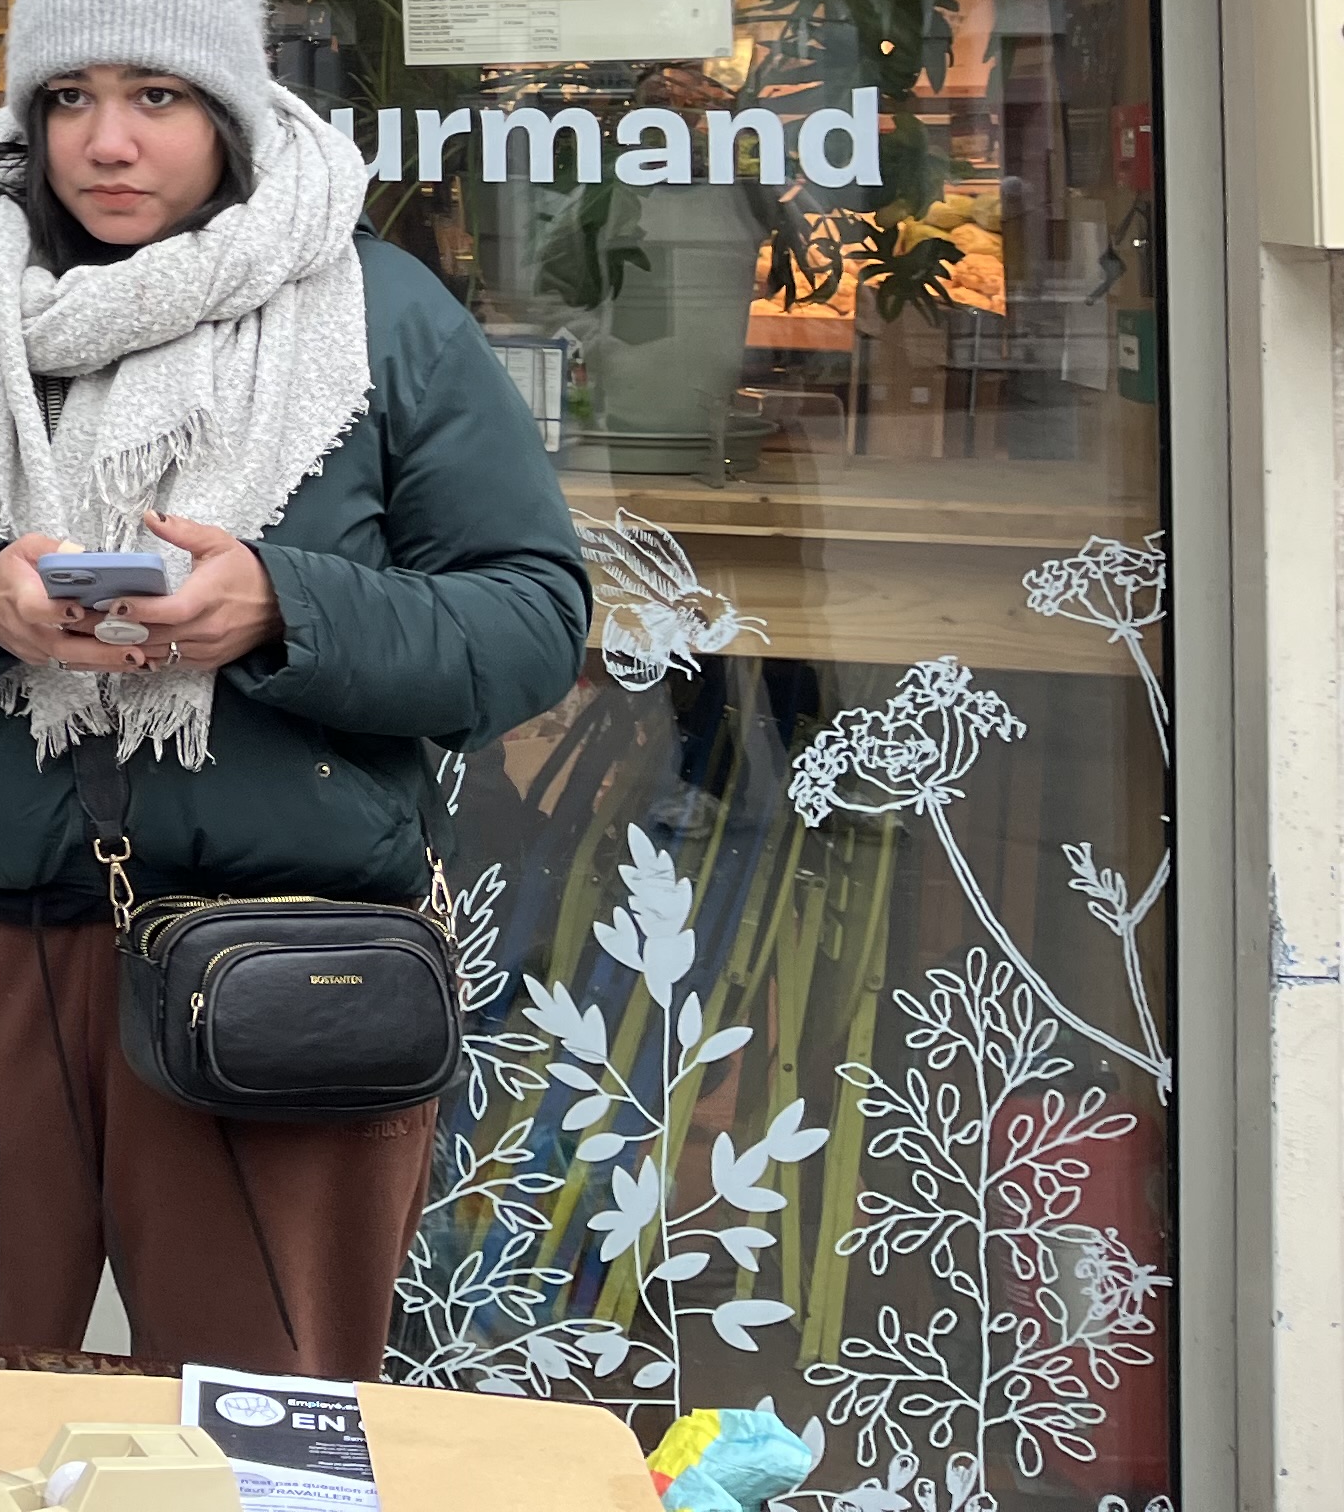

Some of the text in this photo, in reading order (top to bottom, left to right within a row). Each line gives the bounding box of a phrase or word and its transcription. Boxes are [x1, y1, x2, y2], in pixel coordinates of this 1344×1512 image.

[330, 85, 885, 189] urmand
[291, 1412, 346, 1433] EN
[268, 1487, 352, 1502] TRAVAILLER
